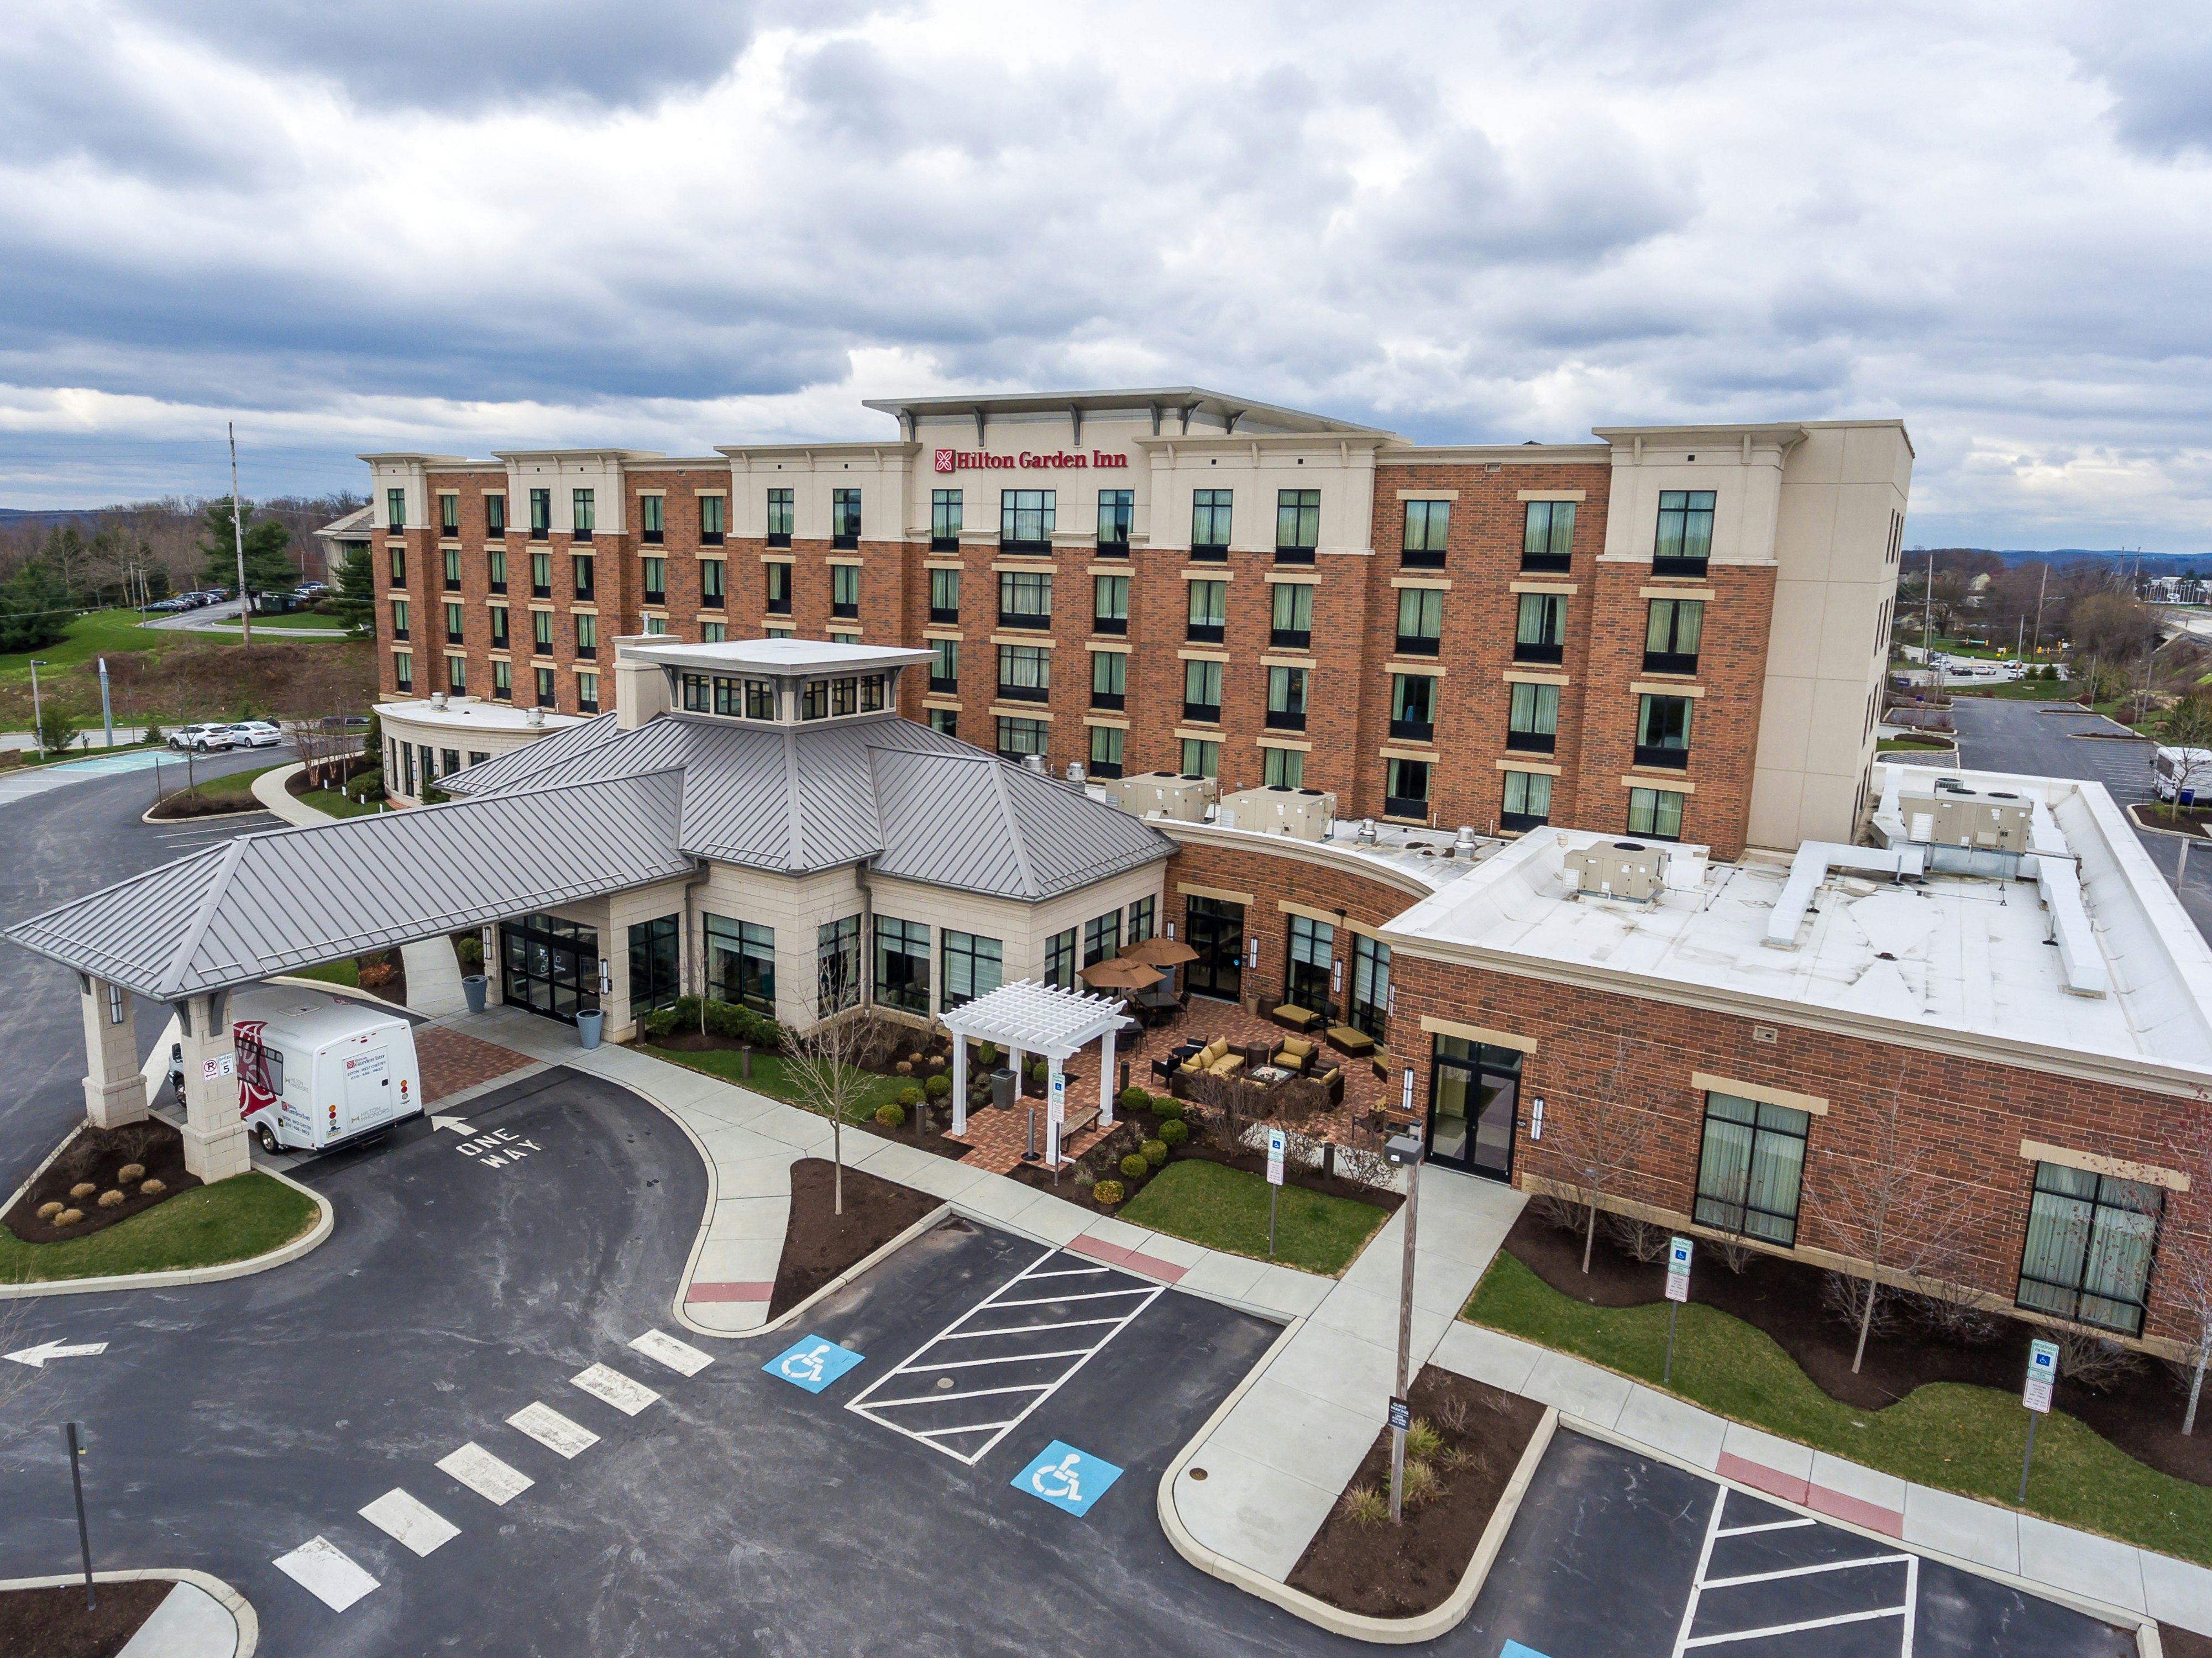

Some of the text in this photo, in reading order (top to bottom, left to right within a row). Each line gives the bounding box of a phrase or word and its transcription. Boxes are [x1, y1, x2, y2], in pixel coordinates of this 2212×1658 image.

[956, 450, 1128, 469] Hilton Garden Inn
[355, 1058, 375, 1067] Garden
[223, 1064, 230, 1073] 5
[360, 1106, 381, 1116] HILTON
[361, 1107, 390, 1121] HHONORS
[455, 1128, 521, 1156] ONE
[479, 1139, 542, 1168] WAY
[2034, 1342, 2057, 1352] RESERVED
[2035, 1347, 2054, 1356] PARKING
[1390, 1405, 1409, 1415] PARKING
